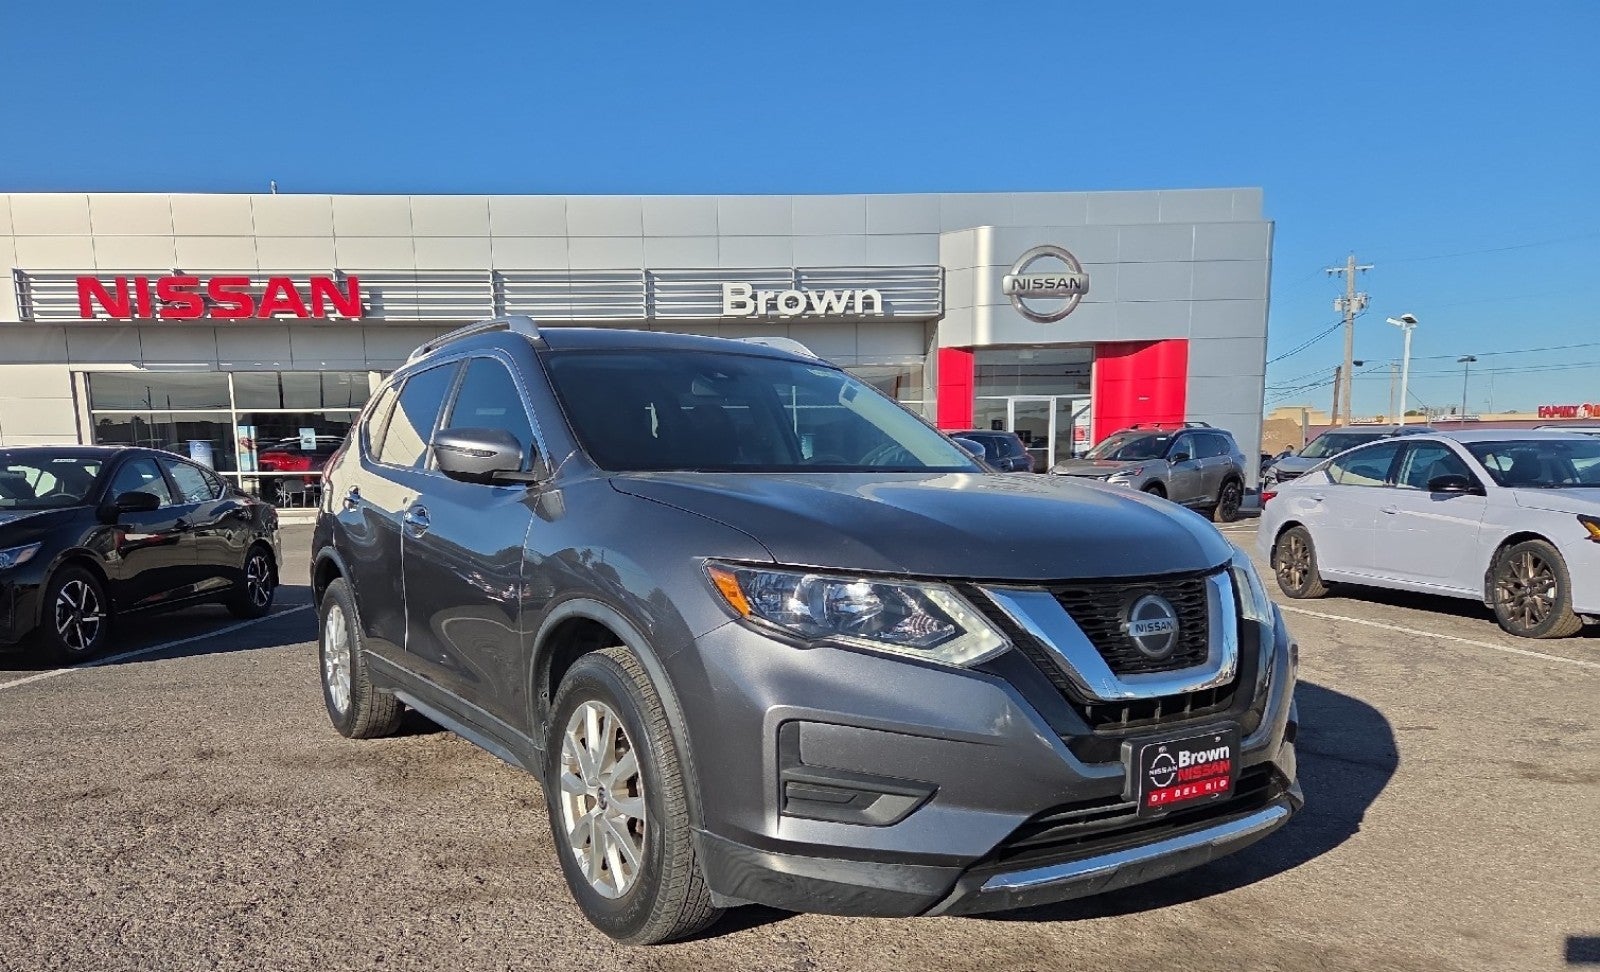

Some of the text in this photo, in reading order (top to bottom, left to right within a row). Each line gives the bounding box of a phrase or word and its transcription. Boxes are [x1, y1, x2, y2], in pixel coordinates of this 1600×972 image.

[1012, 277, 1082, 290] NISSAN
[76, 276, 363, 319] NISSAN
[722, 282, 883, 315] Brown
[1538, 405, 1580, 418] FAMILY
[1135, 620, 1173, 633] NISSAN
[1178, 746, 1230, 768] Brown
[1149, 764, 1178, 776] NISSAN
[1178, 759, 1231, 782] NISSAN
[1151, 779, 1227, 802] OF DEL RIO
